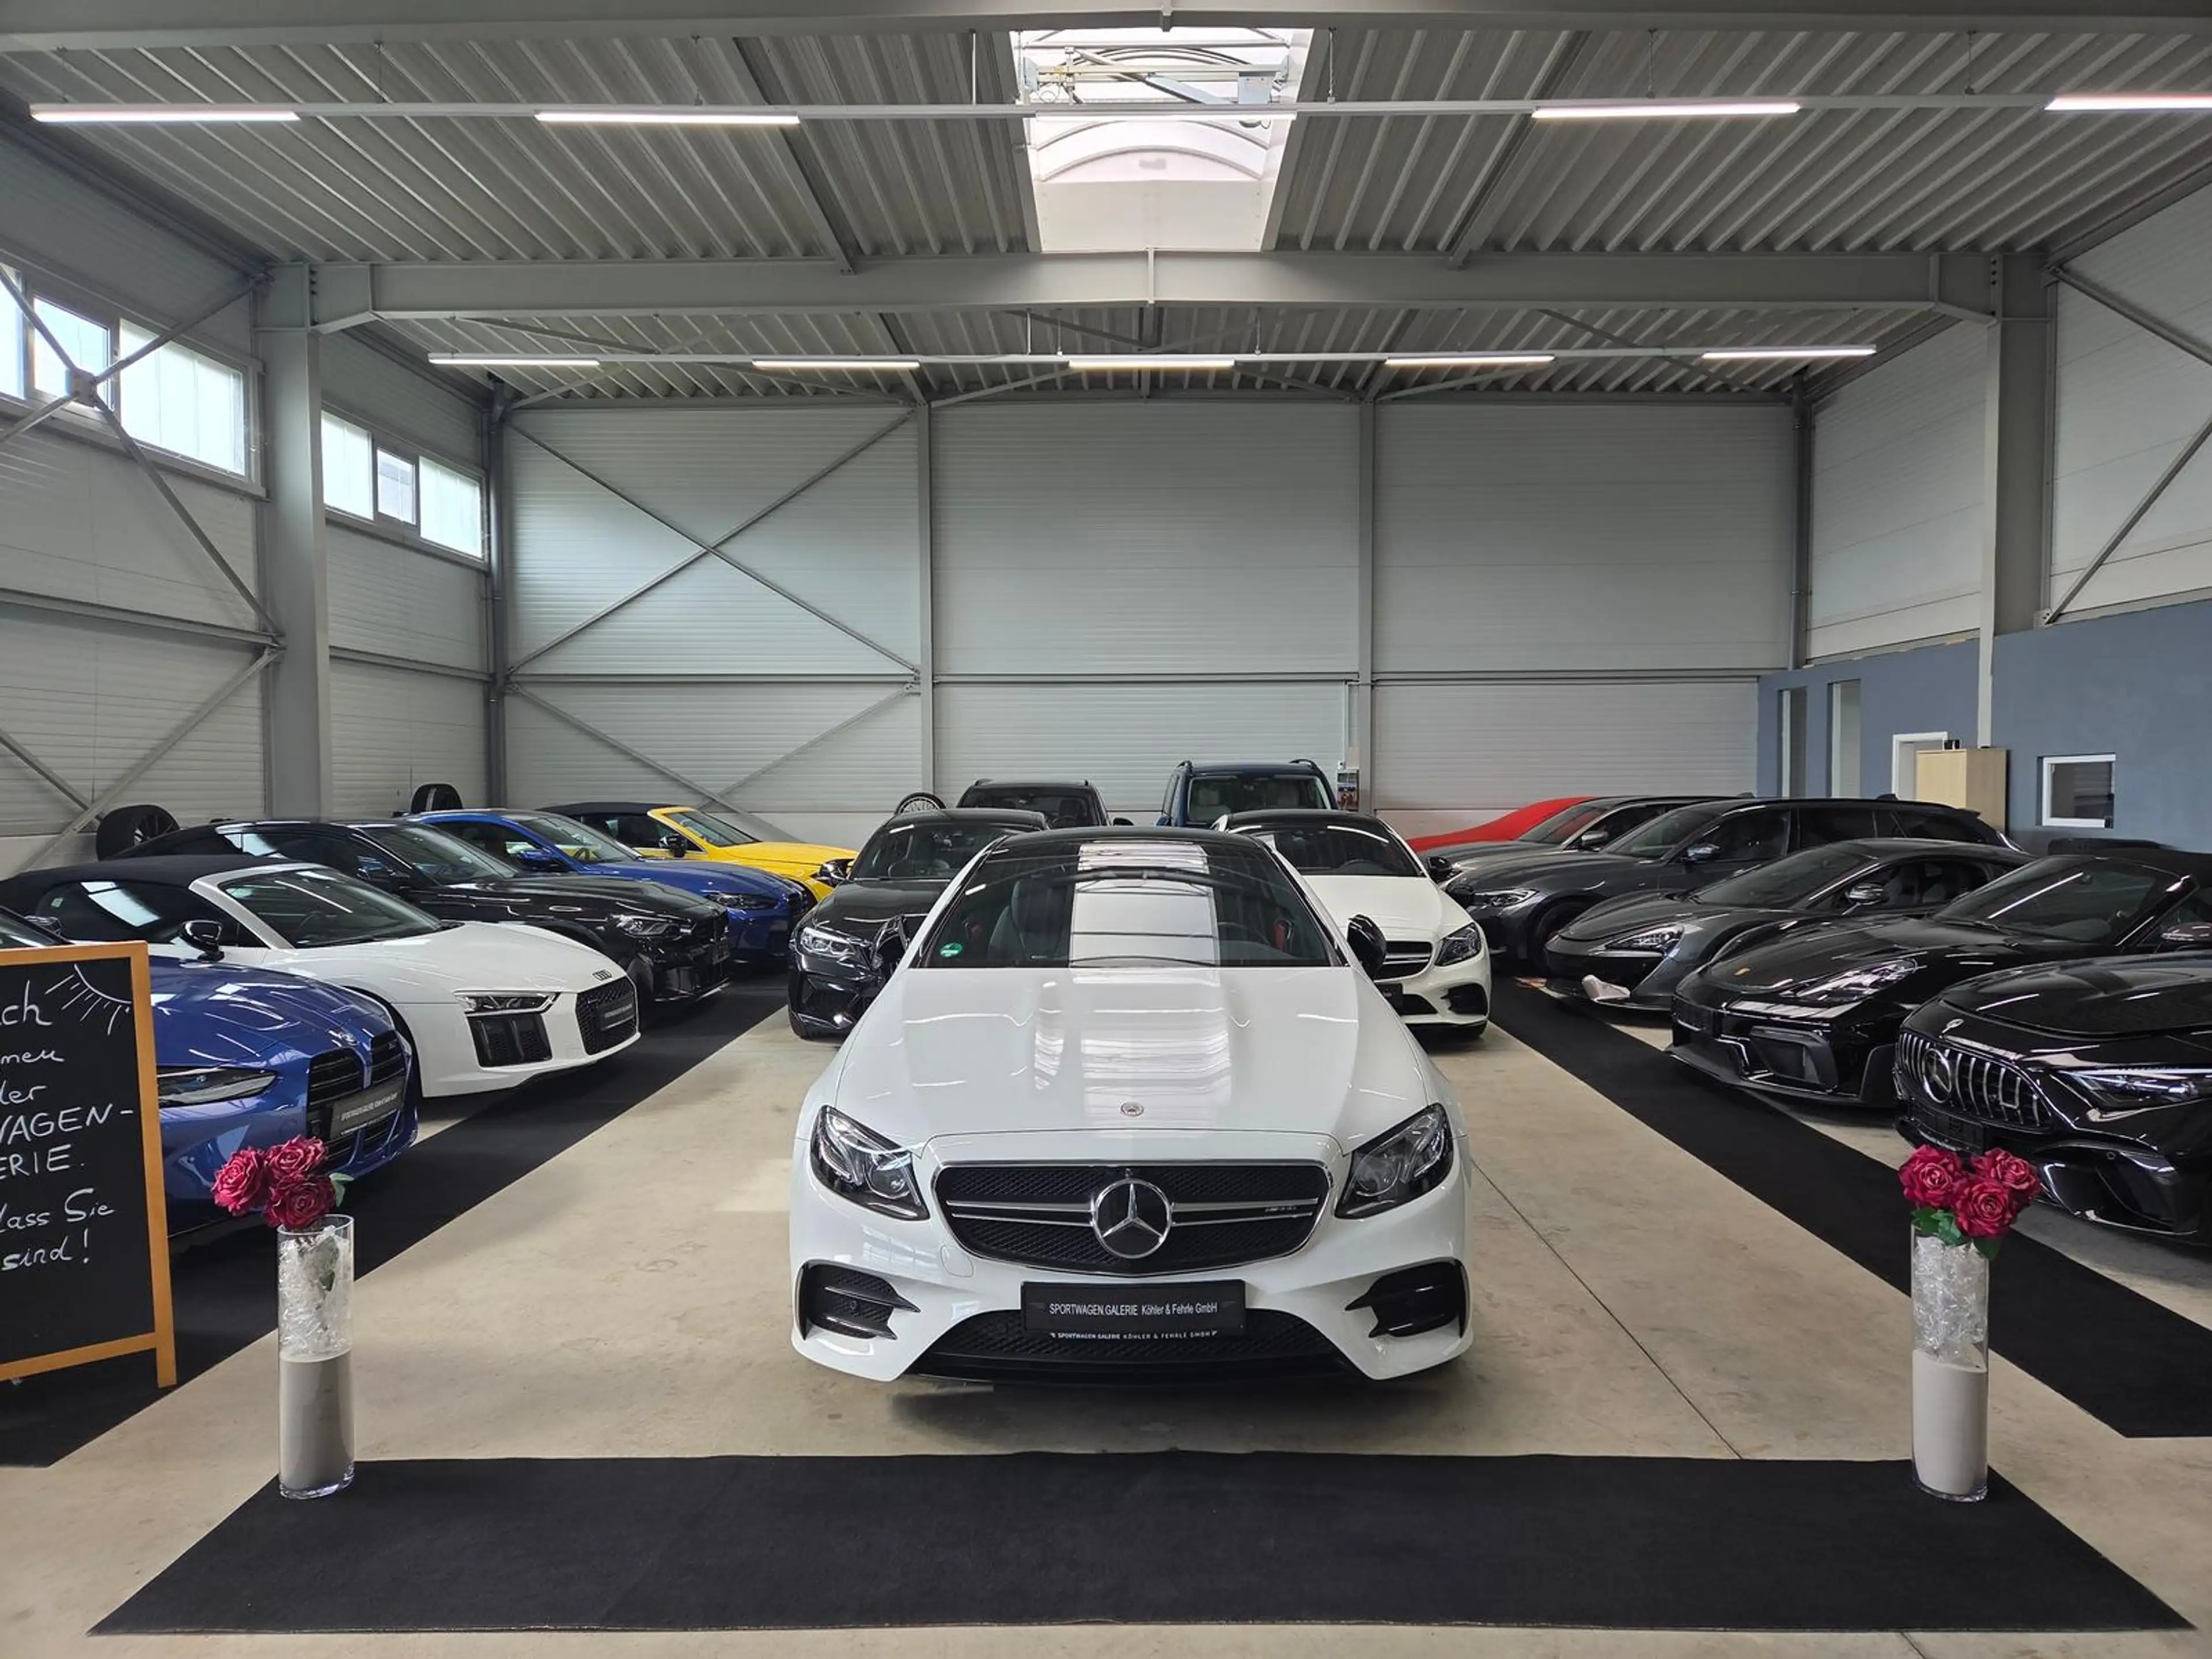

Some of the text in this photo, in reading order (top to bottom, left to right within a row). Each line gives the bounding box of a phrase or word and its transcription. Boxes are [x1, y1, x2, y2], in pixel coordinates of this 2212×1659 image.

[0, 979, 52, 1025] ch
[65, 1188, 116, 1222] Sie
[1165, 1304, 1171, 1315] &
[1172, 1303, 1194, 1315] Fehrle
[1195, 1302, 1218, 1314] GmbH
